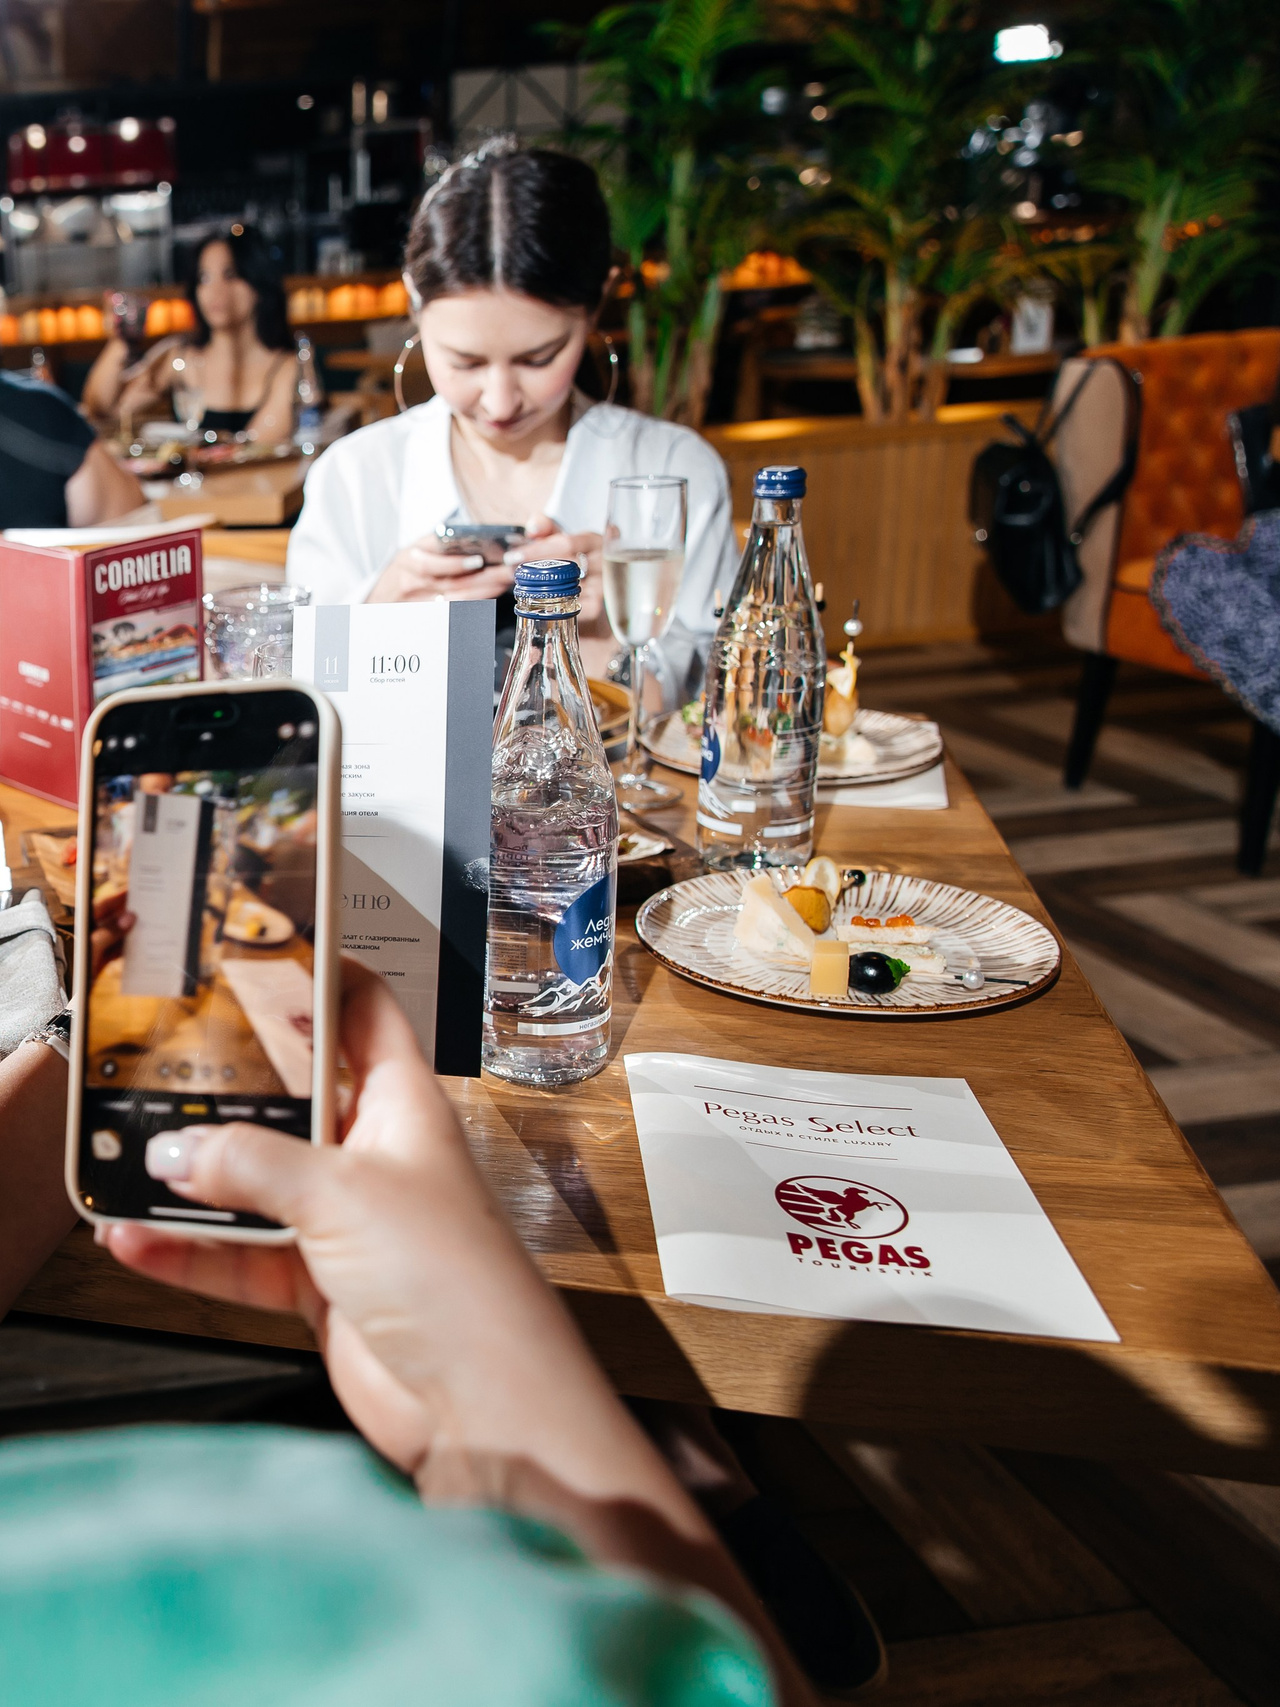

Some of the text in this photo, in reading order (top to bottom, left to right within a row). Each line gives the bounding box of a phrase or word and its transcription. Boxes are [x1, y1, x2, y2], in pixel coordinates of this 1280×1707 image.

[95, 544, 191, 594] CORNELIA
[323, 655, 340, 675] 11
[370, 654, 421, 674] 11:00
[340, 943, 380, 951] аклажаном
[365, 934, 420, 943] глазированным
[570, 930, 612, 951] жемчу
[703, 1101, 921, 1138] Pegas Select
[843, 1139, 892, 1148] LUXURY
[785, 1231, 932, 1270] PEGAS
[796, 1257, 934, 1278] TOURISTIK
